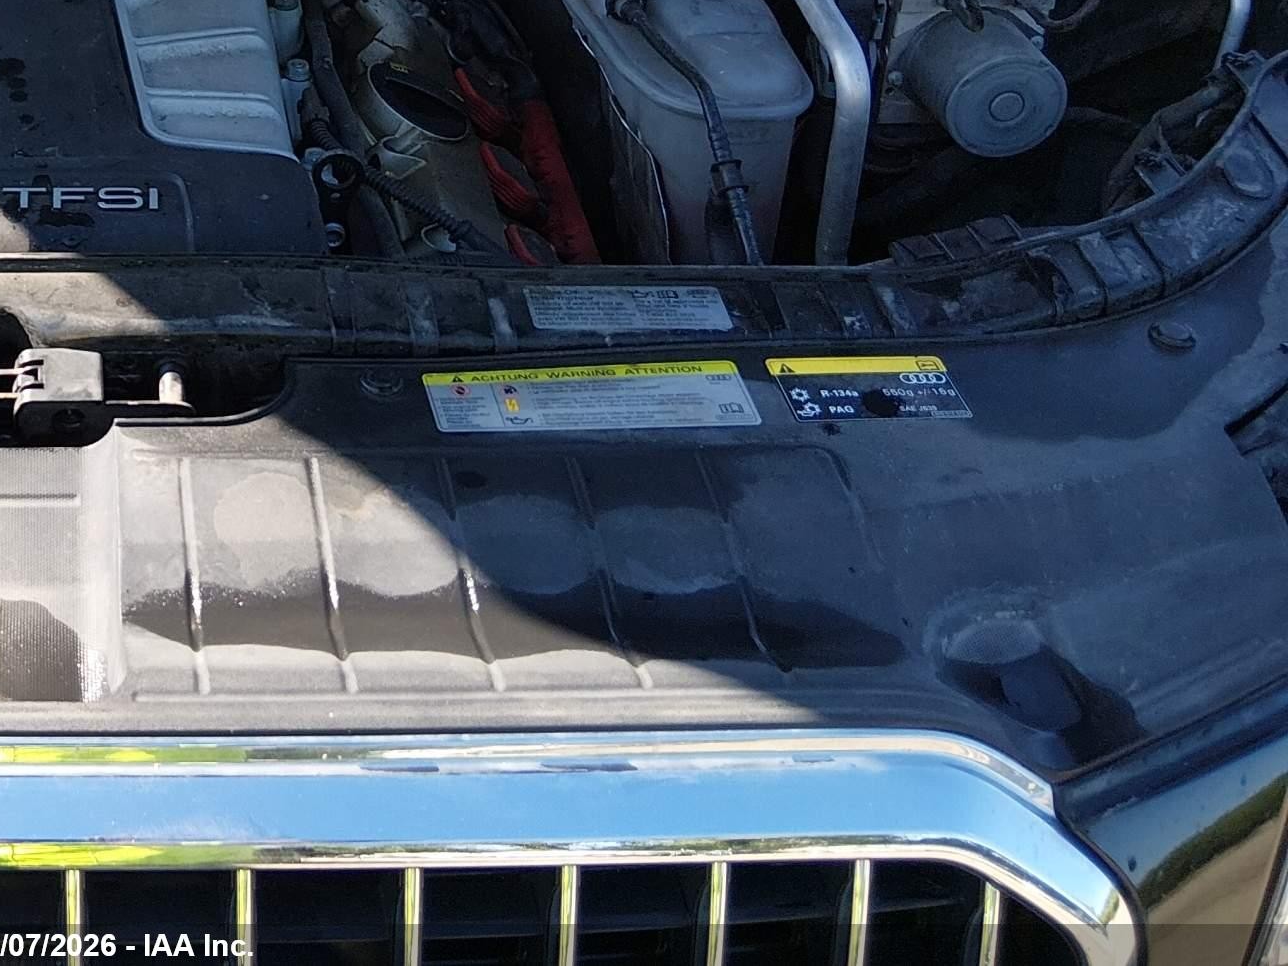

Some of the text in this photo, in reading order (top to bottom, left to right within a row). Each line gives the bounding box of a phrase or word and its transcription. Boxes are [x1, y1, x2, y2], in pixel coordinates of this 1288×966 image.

[2, 187, 160, 210] TFSI
[471, 365, 703, 383] ACHTUNG WARNING ATTENTION
[820, 389, 859, 398] R-134a
[828, 405, 855, 414] PAG
